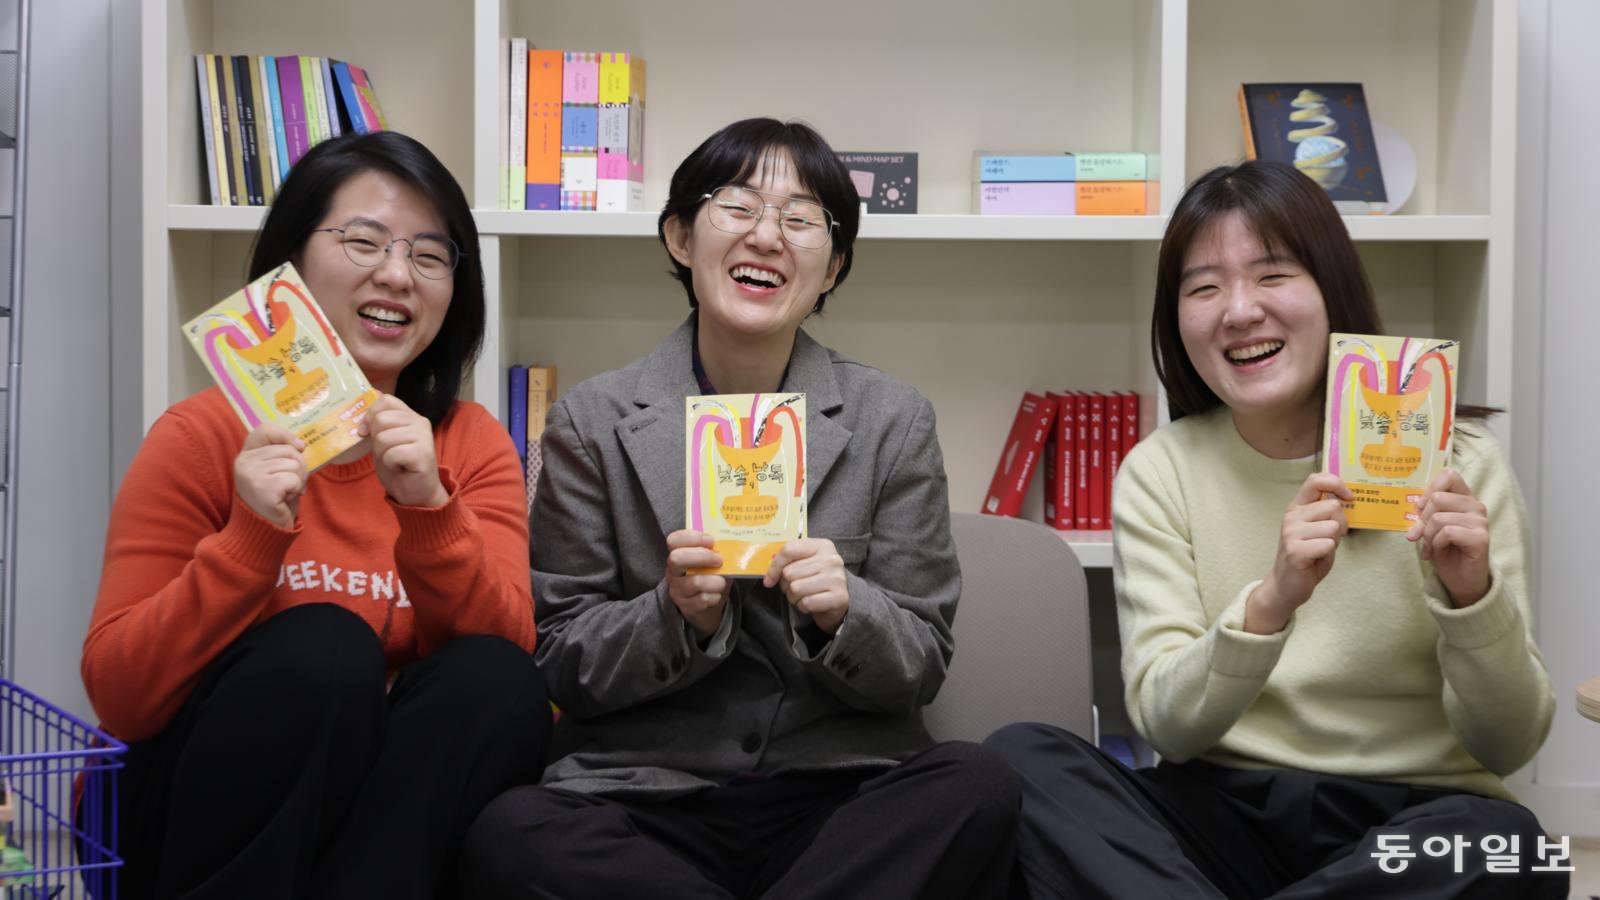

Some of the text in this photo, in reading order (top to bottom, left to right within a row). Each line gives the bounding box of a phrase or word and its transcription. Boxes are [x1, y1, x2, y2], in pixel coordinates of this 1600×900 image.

[852, 155, 872, 163] MIND
[873, 155, 889, 163] MAP
[752, 461, 784, 484] 낭독
[275, 560, 412, 607] EEKEN
